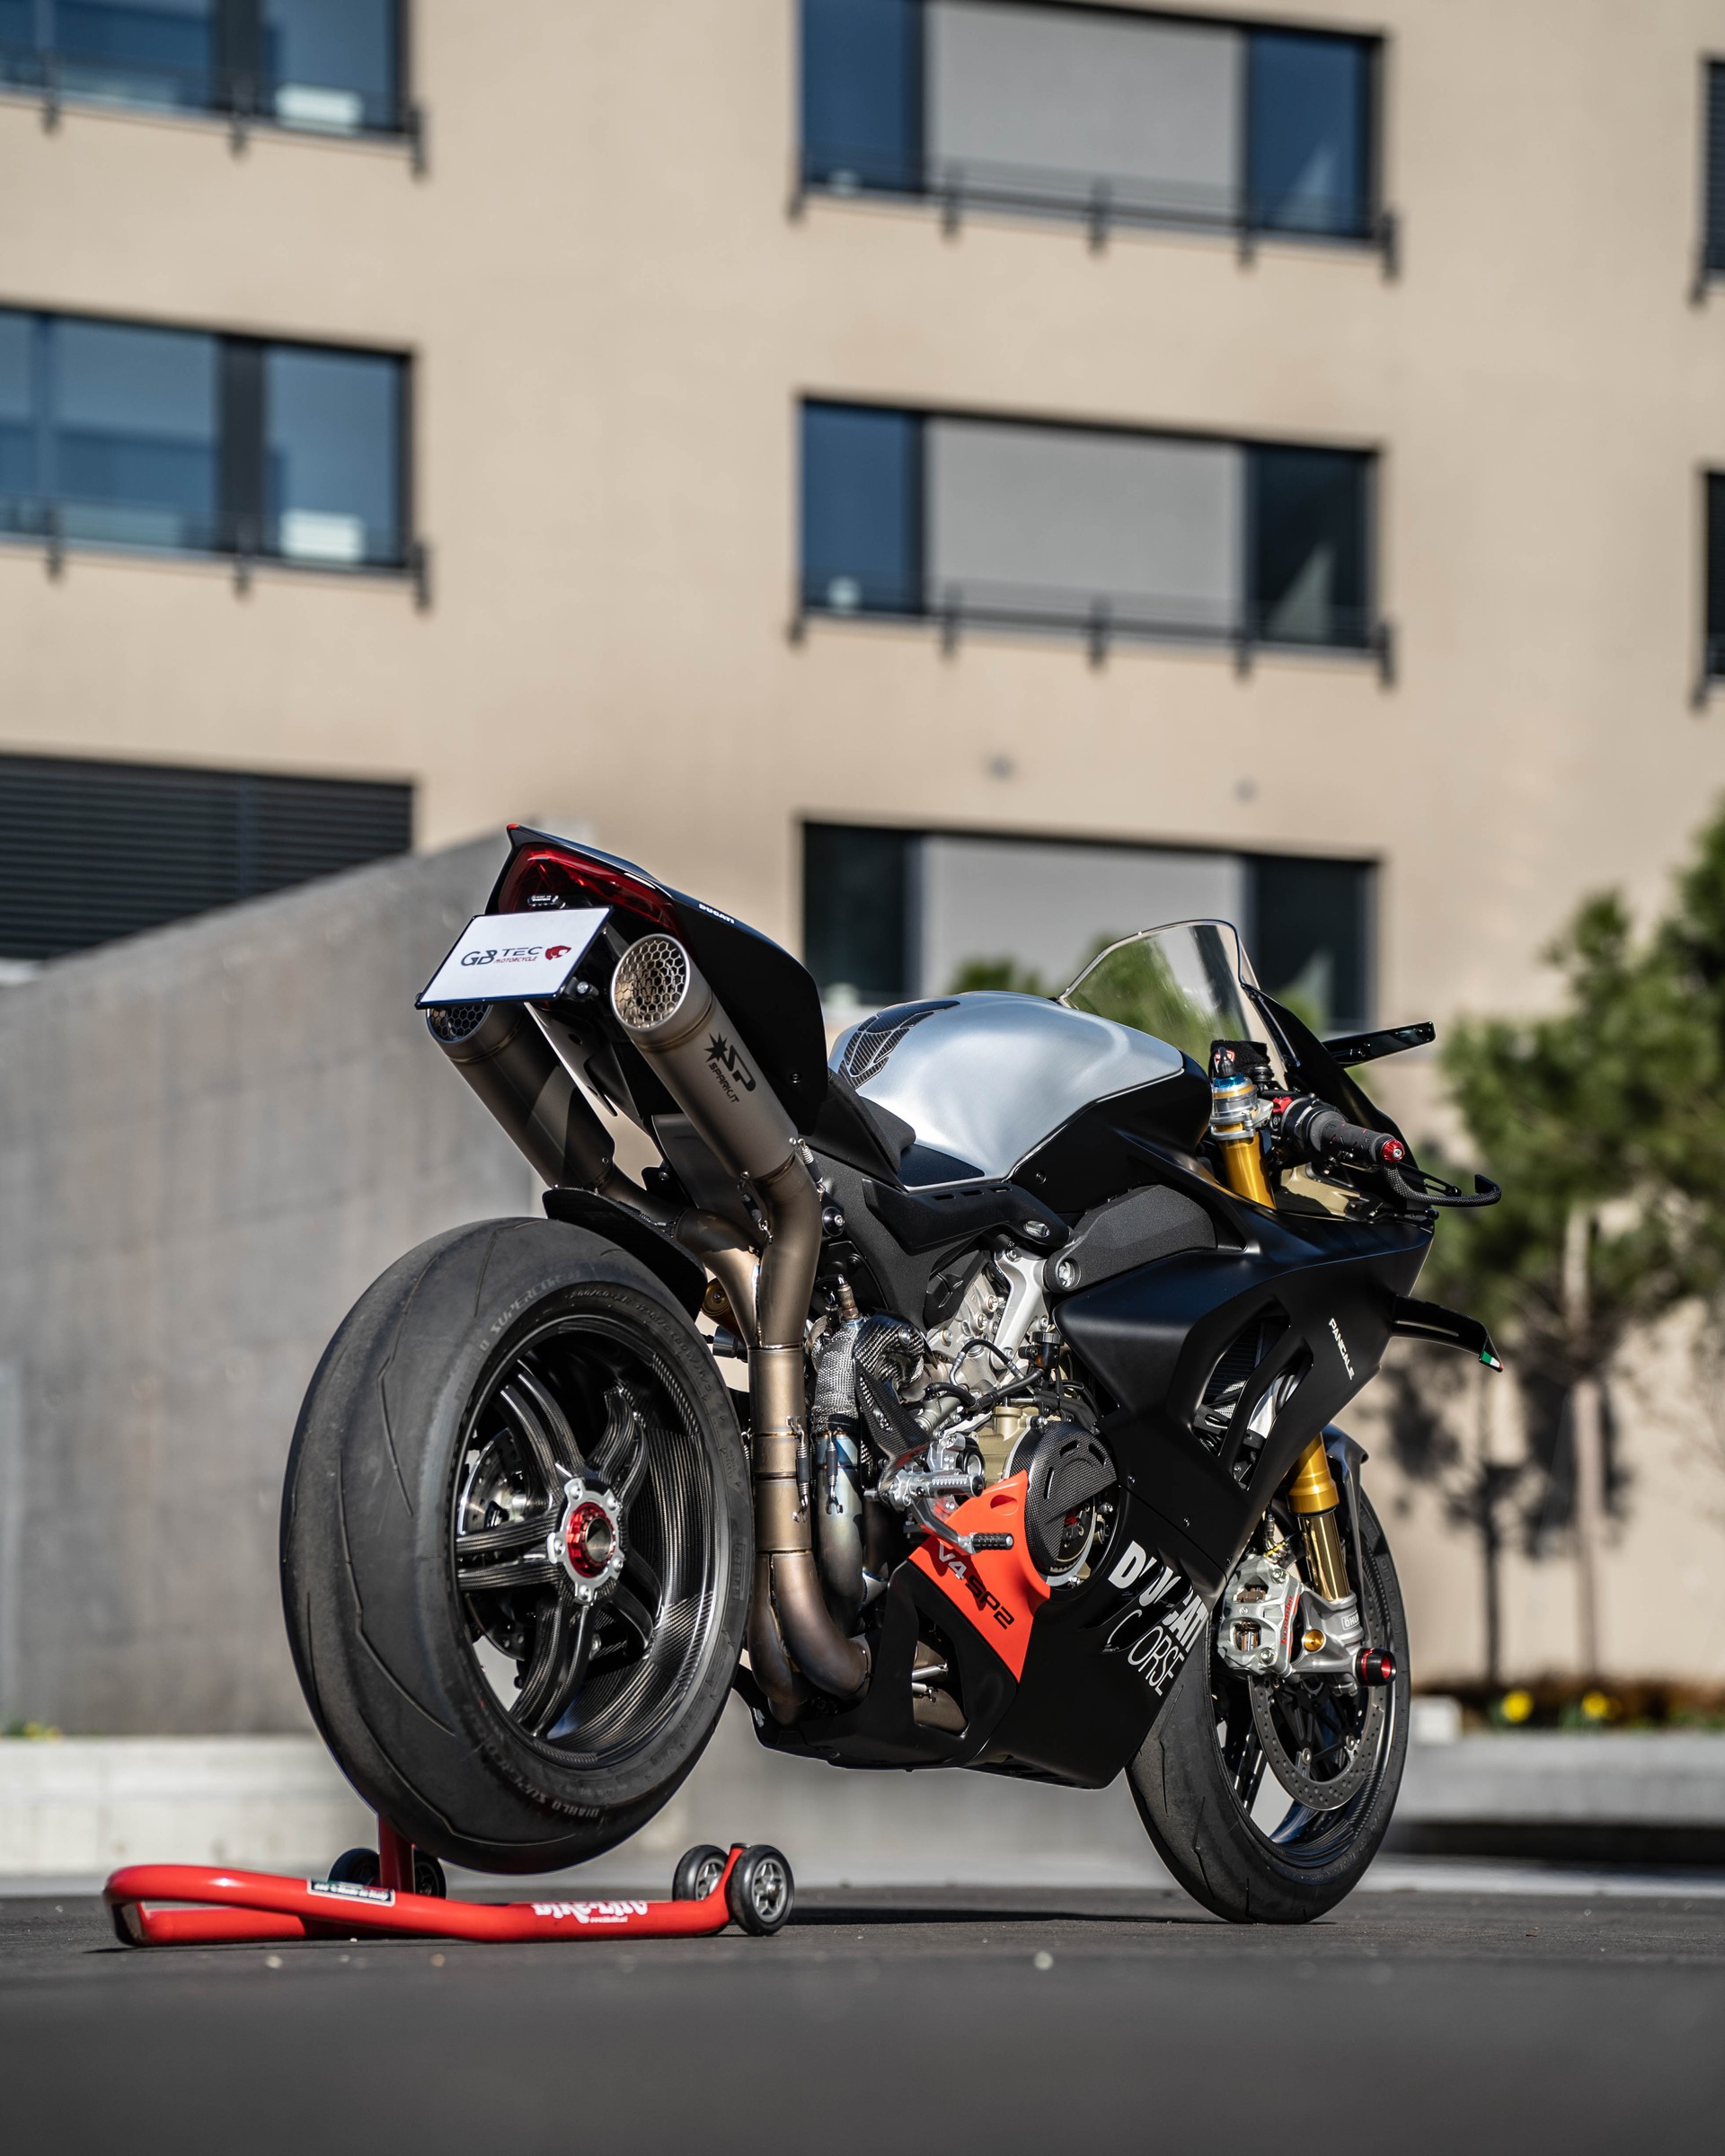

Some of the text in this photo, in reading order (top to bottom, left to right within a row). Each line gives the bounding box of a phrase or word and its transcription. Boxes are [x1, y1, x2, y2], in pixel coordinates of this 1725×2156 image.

[698, 903, 735, 924] DUCATI
[493, 956, 538, 964] MOTORCYCLE
[501, 946, 544, 957] TEC
[1328, 1317, 1355, 1381] PANIGALE
[937, 1540, 1015, 1630] V4 SP2
[1280, 1595, 1295, 1647] brembo
[551, 1799, 600, 1818] DIABLO
